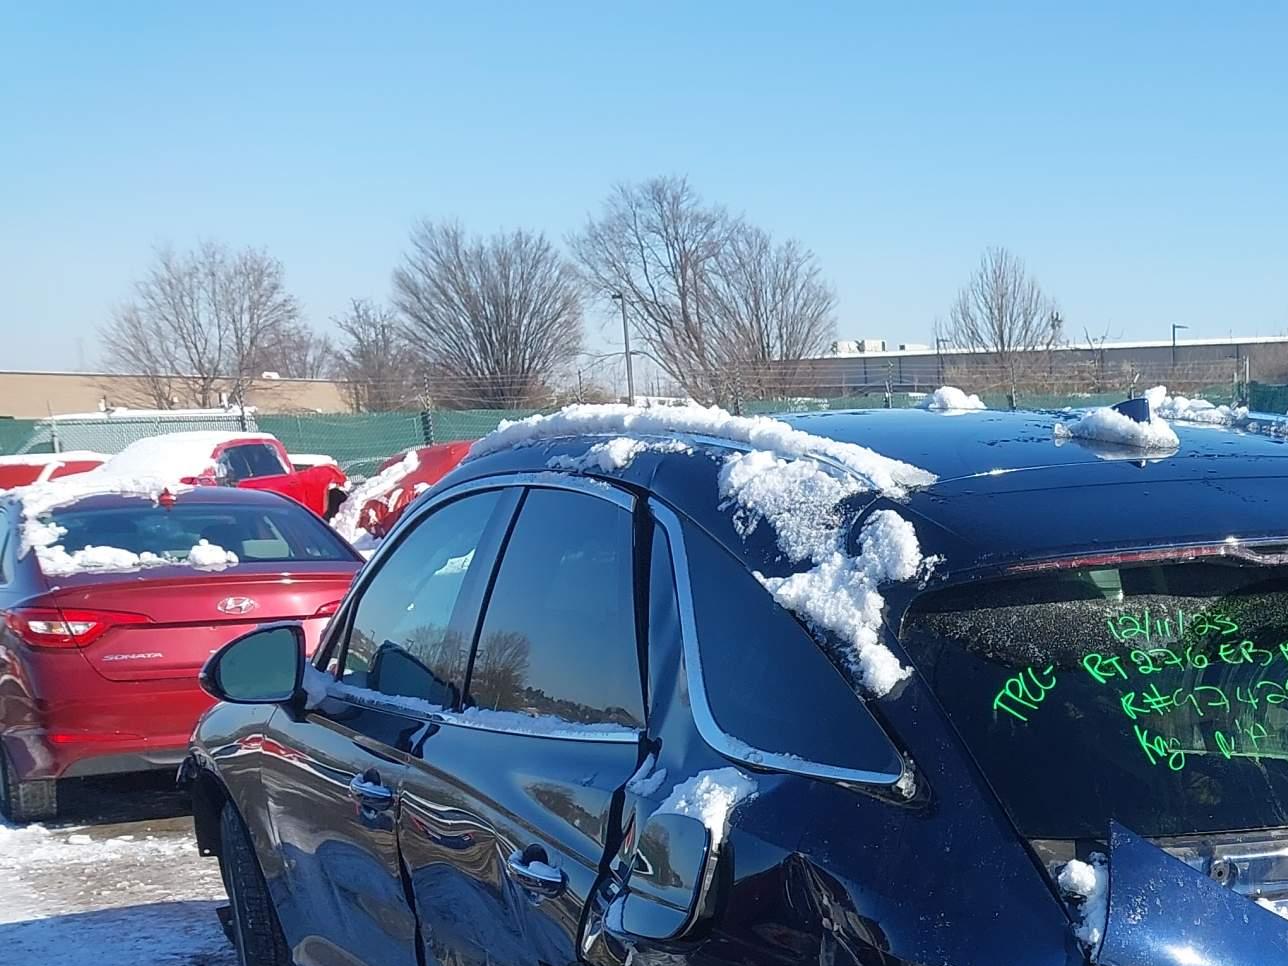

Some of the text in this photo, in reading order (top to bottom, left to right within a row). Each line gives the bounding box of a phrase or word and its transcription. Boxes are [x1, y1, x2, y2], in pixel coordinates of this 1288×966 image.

[103, 652, 163, 662] SONATA
[1082, 652, 1128, 685] RT
[1130, 646, 1211, 675] 276
